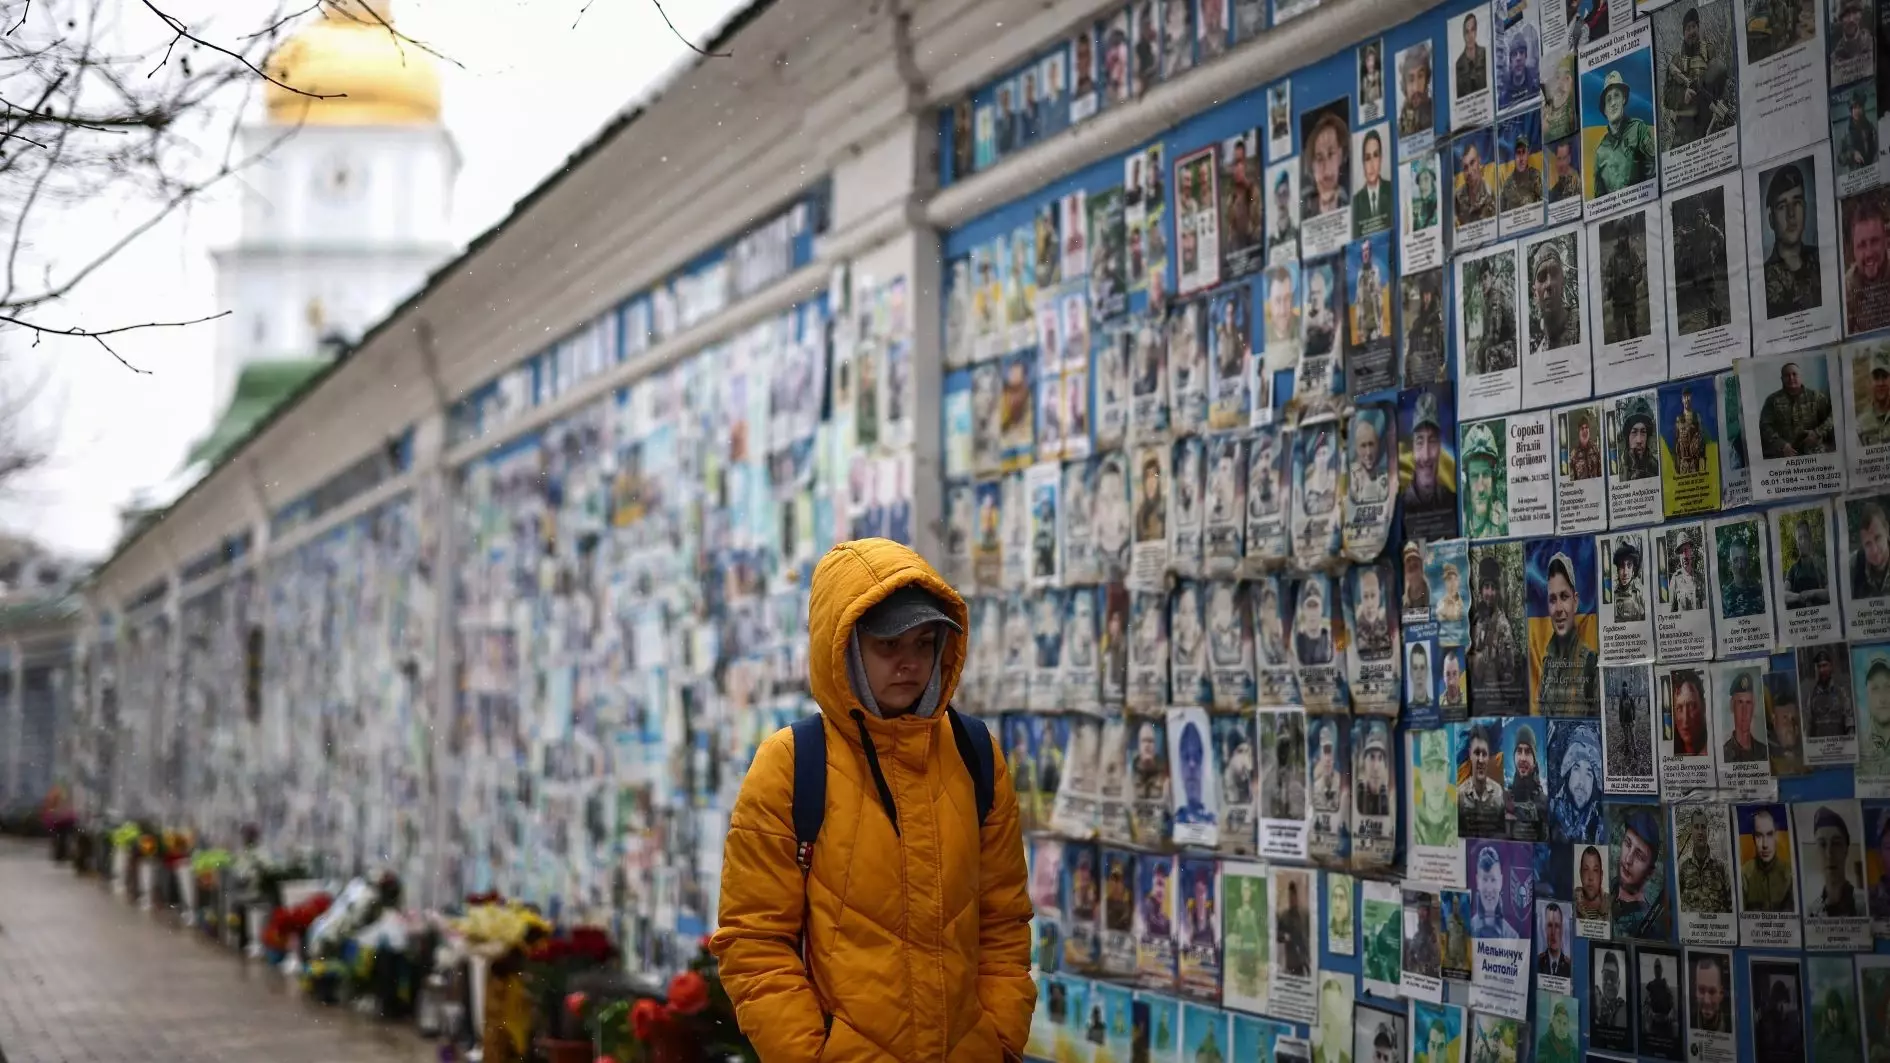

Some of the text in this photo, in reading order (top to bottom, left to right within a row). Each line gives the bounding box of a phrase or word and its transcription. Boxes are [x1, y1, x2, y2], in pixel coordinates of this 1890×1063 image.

[1511, 421, 1544, 441] Сорокін
[1516, 440, 1540, 453] Віталій
[1786, 457, 1817, 467] АБДУЛІН
[1769, 465, 1835, 477] Сергій Михайлович
[1477, 941, 1523, 963] Мельничук
[1482, 959, 1518, 977] Анатолій
